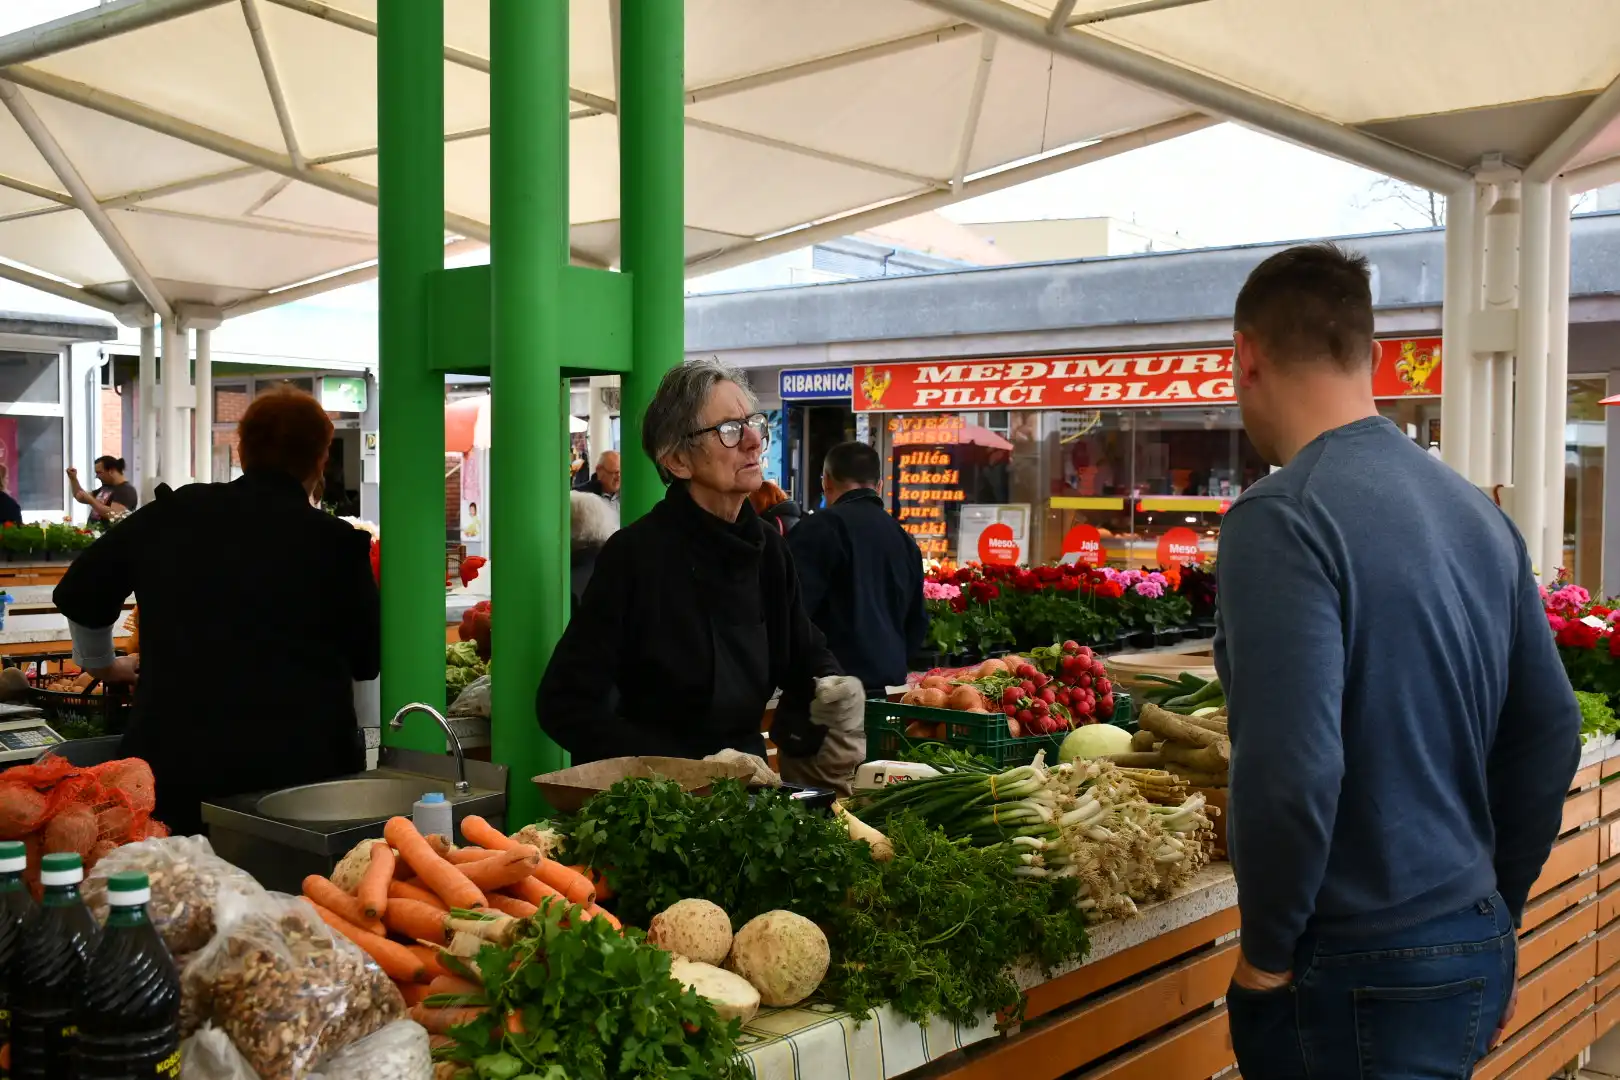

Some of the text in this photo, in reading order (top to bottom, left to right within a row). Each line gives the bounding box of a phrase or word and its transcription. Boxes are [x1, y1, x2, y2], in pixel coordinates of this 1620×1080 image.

[783, 373, 852, 392] RIBARNICA
[913, 380, 1046, 406] PILIĆI
[888, 413, 965, 431] SVJEŽE
[898, 451, 951, 468] pilića
[898, 469, 959, 484] kokoši
[898, 486, 965, 504] kopuna
[898, 506, 940, 520] pura
[1080, 540, 1099, 552] Jaja
[1169, 543, 1197, 554] Meso
